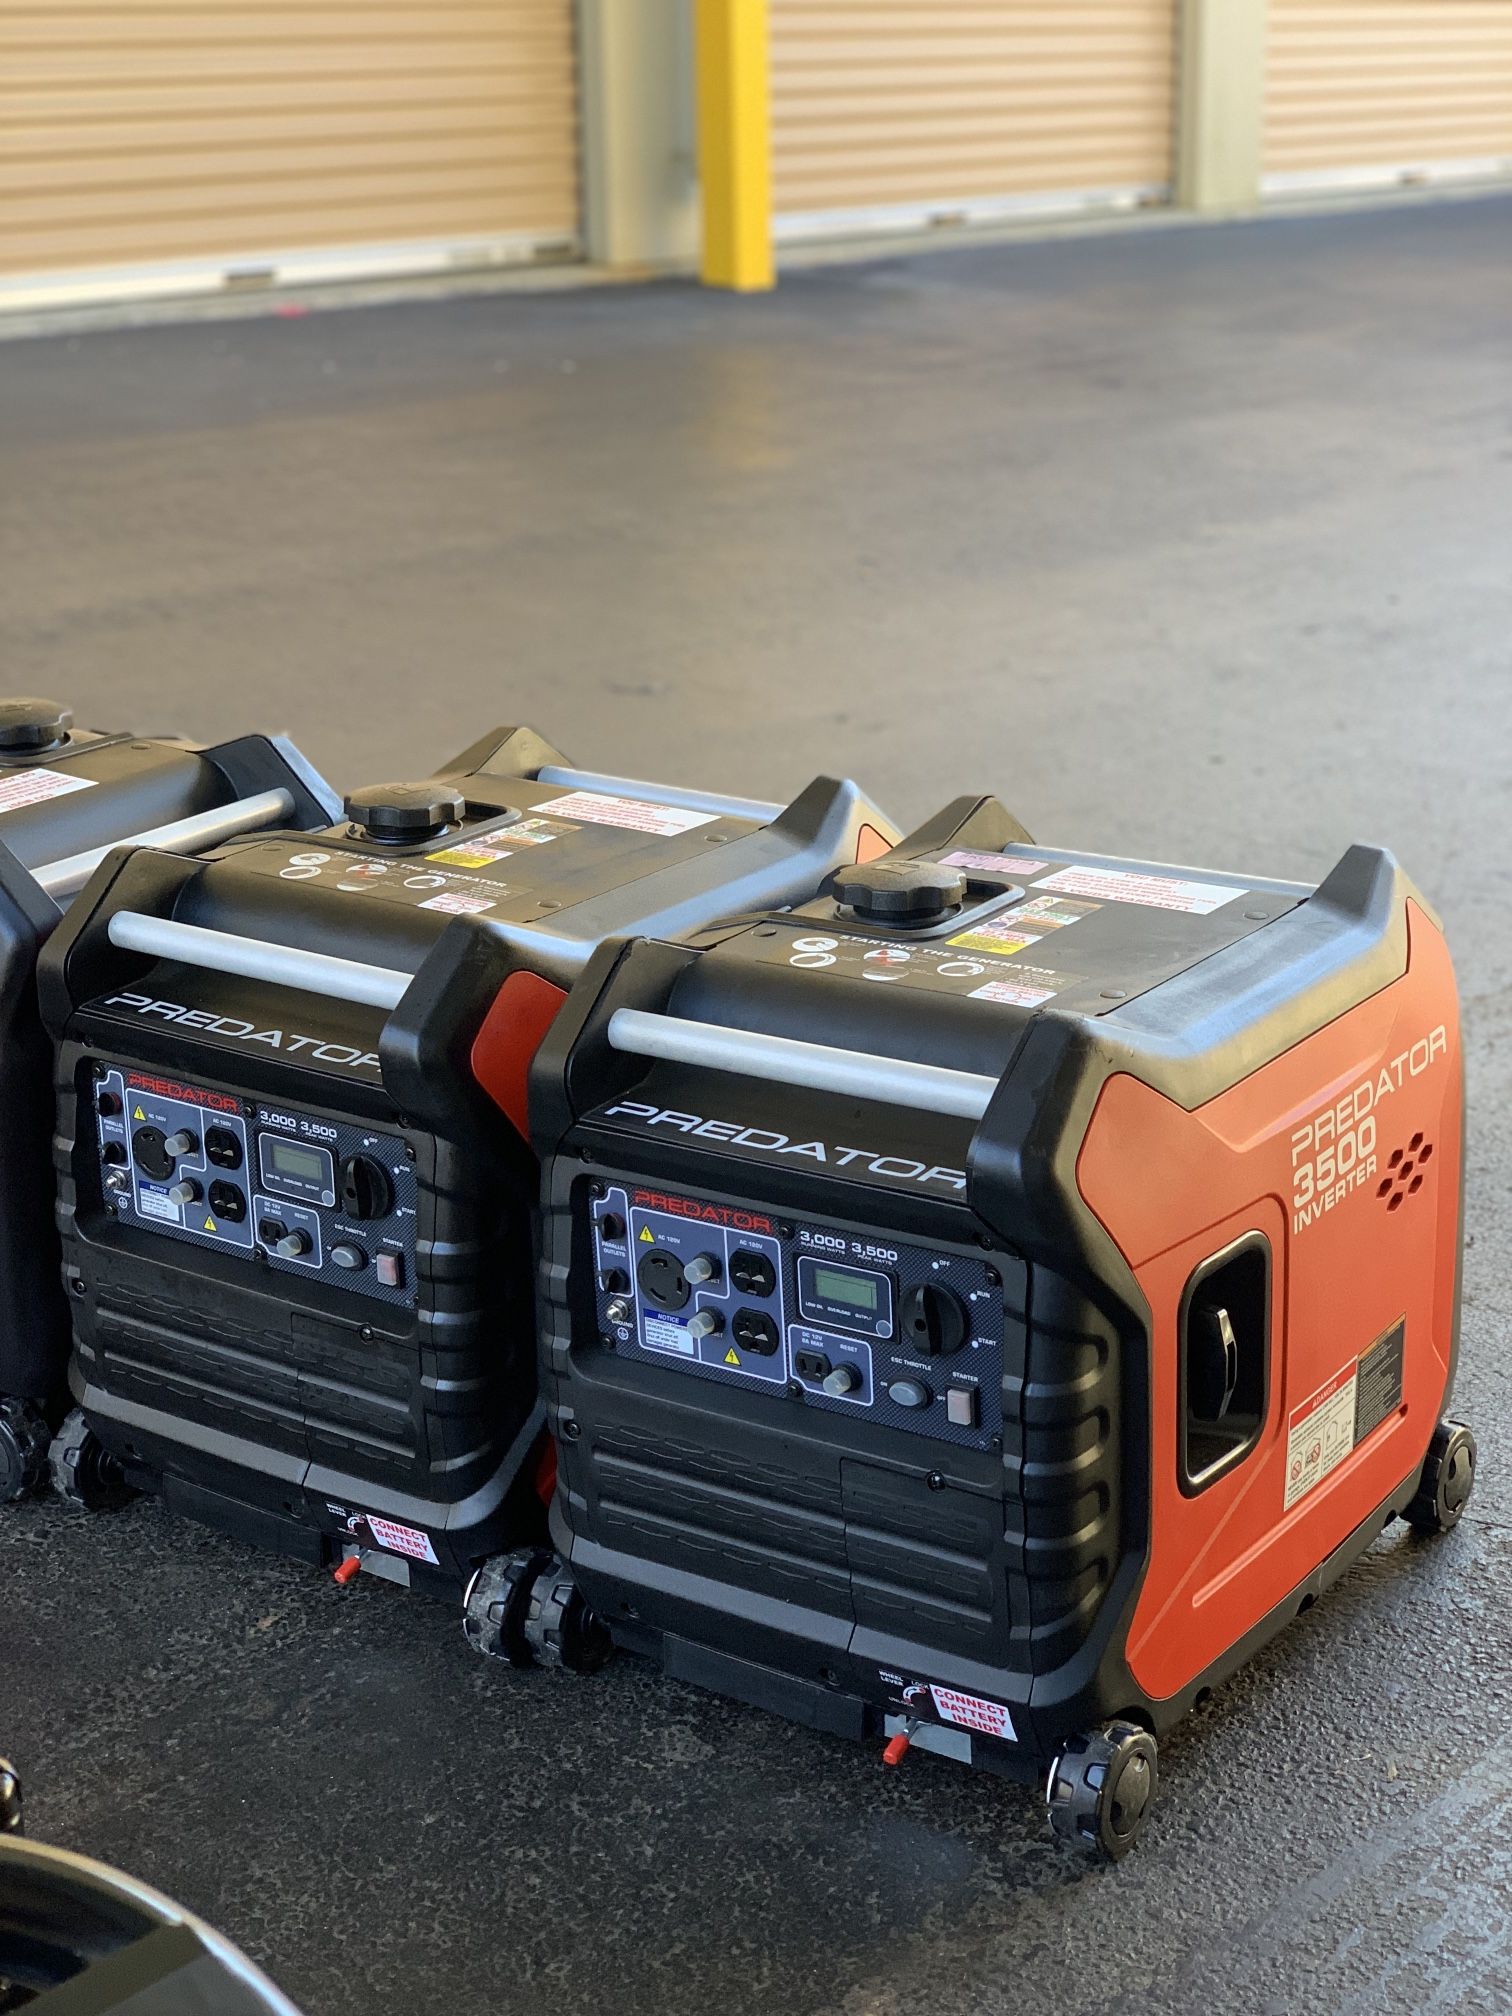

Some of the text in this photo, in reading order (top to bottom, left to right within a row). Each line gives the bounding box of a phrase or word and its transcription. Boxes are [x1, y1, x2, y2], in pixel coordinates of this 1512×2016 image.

[597, 818, 663, 833] WARRANTY
[334, 850, 398, 866] STARTING
[400, 862, 427, 872] THE
[427, 868, 507, 888] GENERATOR
[1113, 895, 1193, 912] WARRANTY
[839, 935, 917, 951] STARTING
[921, 948, 955, 958] THE
[956, 954, 1056, 975] GENERATOR
[128, 1073, 238, 1111] PREDATOR
[1290, 1024, 1448, 1167] PREDATOR
[260, 1110, 338, 1139] 3,000 3,500
[604, 1101, 967, 1190] PREDATOR
[1292, 1115, 1377, 1208] 3500
[149, 1184, 168, 1194] NOTICE
[1293, 1154, 1378, 1235] INVERTER
[634, 1190, 772, 1232] PREDATOR
[601, 1240, 627, 1252] PARALLEL
[603, 1247, 626, 1258] OUTLETS
[800, 1230, 898, 1261] 3,000 3,500
[826, 1246, 846, 1255] WATTS
[873, 1257, 893, 1266] WATTS
[939, 1259, 951, 1267] OFF
[976, 1290, 991, 1299] RUN
[611, 1318, 633, 1328] GROUND
[657, 1312, 680, 1324] NOTICE
[854, 1312, 873, 1321] OUTPUT
[810, 1339, 824, 1348] MAX
[811, 1332, 823, 1340] 12V
[977, 1337, 997, 1347] START
[839, 1343, 859, 1353] RESET
[890, 1356, 932, 1371] ESC THROTTLE
[952, 1371, 979, 1383] STARTER
[1315, 1380, 1338, 1408] DANGER
[369, 1516, 427, 1542] CONNECT
[375, 1529, 429, 1552] BATTERY
[386, 1540, 427, 1560] INSIDE
[878, 1670, 904, 1682] WHEEL
[880, 1676, 904, 1687] LEVER
[933, 1687, 1007, 1717] CONNECT
[939, 1700, 1008, 1727] BATTERY
[951, 1712, 1004, 1736] INSIDE
